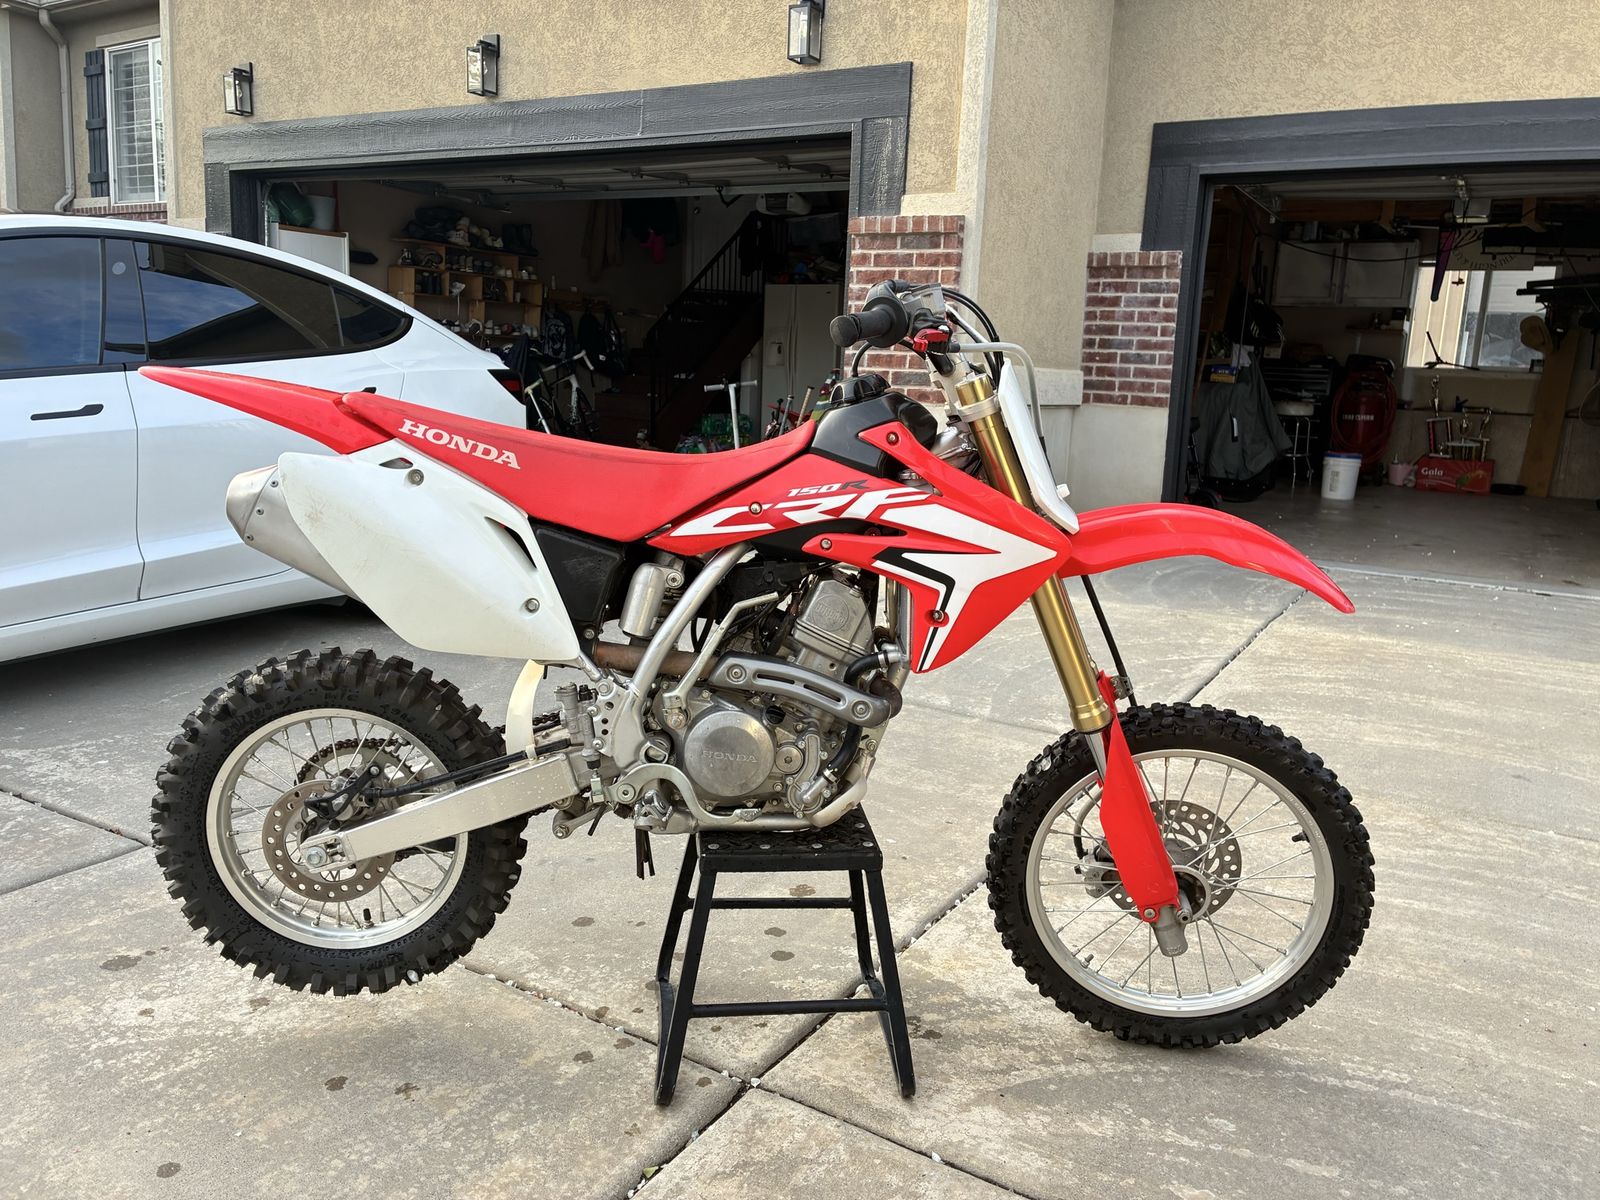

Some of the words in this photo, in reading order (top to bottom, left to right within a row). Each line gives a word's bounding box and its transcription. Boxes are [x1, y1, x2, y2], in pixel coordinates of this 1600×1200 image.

[398, 418, 520, 469] HONDA
[1421, 467, 1444, 477] Gala
[787, 480, 869, 497] 150R
[669, 487, 932, 537] CRF
[702, 750, 760, 763] HONDA
